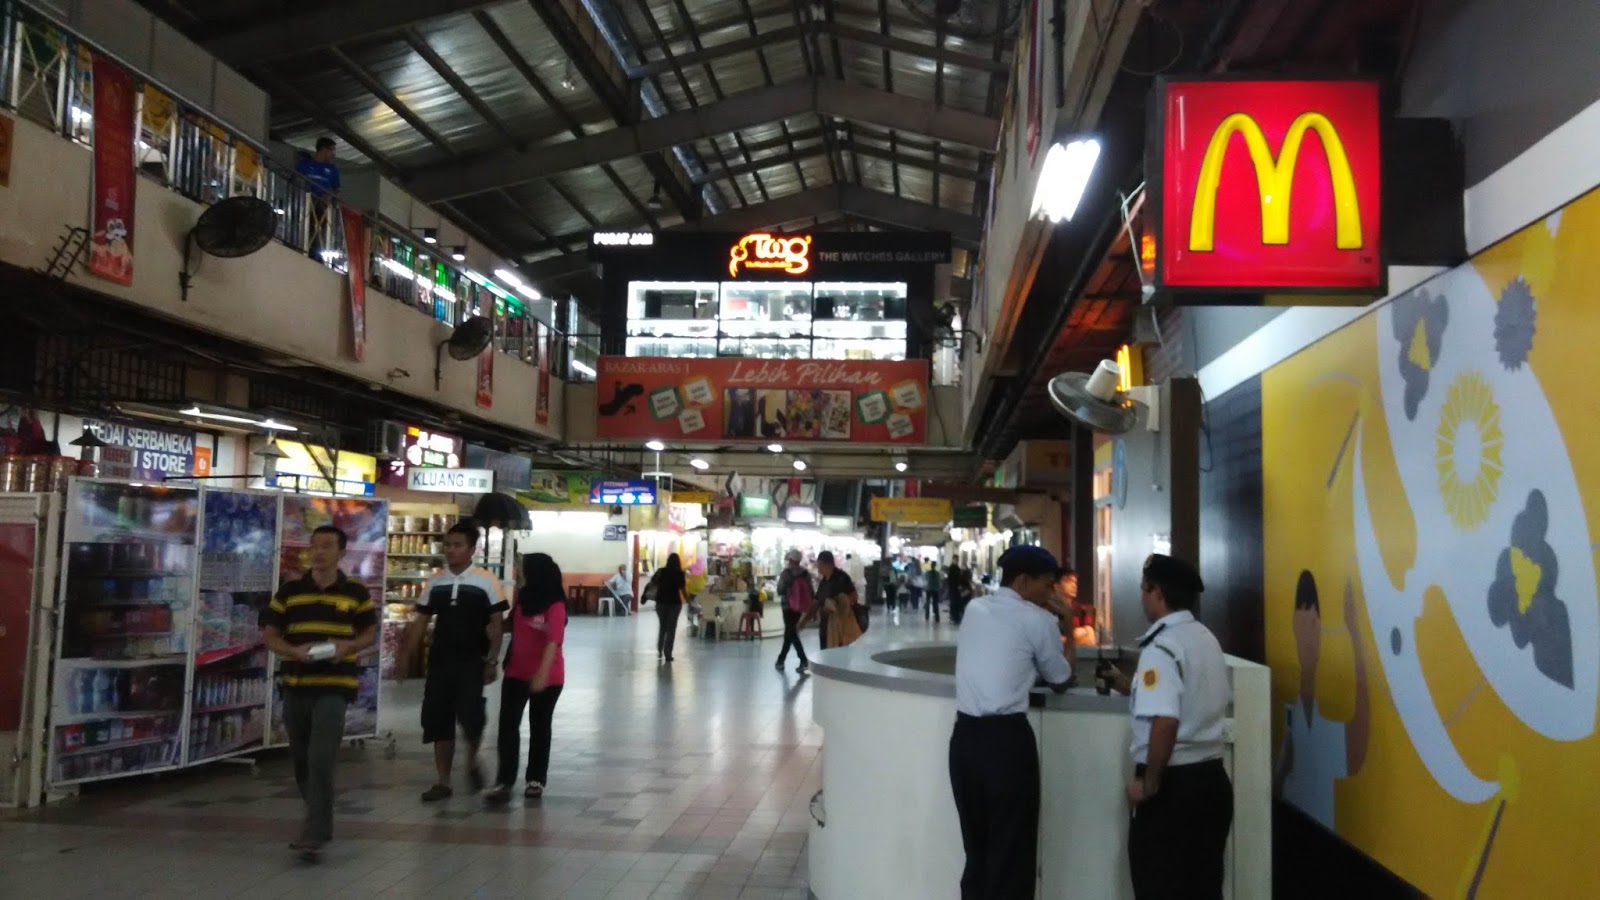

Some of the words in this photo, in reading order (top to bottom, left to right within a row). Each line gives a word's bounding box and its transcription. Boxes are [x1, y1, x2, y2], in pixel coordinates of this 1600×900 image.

[819, 251, 839, 262] THE
[841, 251, 892, 262] WATCHES
[896, 252, 946, 262] GALLERY
[605, 362, 646, 373] BAZAR
[728, 361, 790, 383] Lebih
[796, 362, 883, 385] Pilihan
[127, 429, 194, 455] SERBANEKA
[142, 451, 187, 473] STORE
[412, 472, 465, 487] KLUANG
